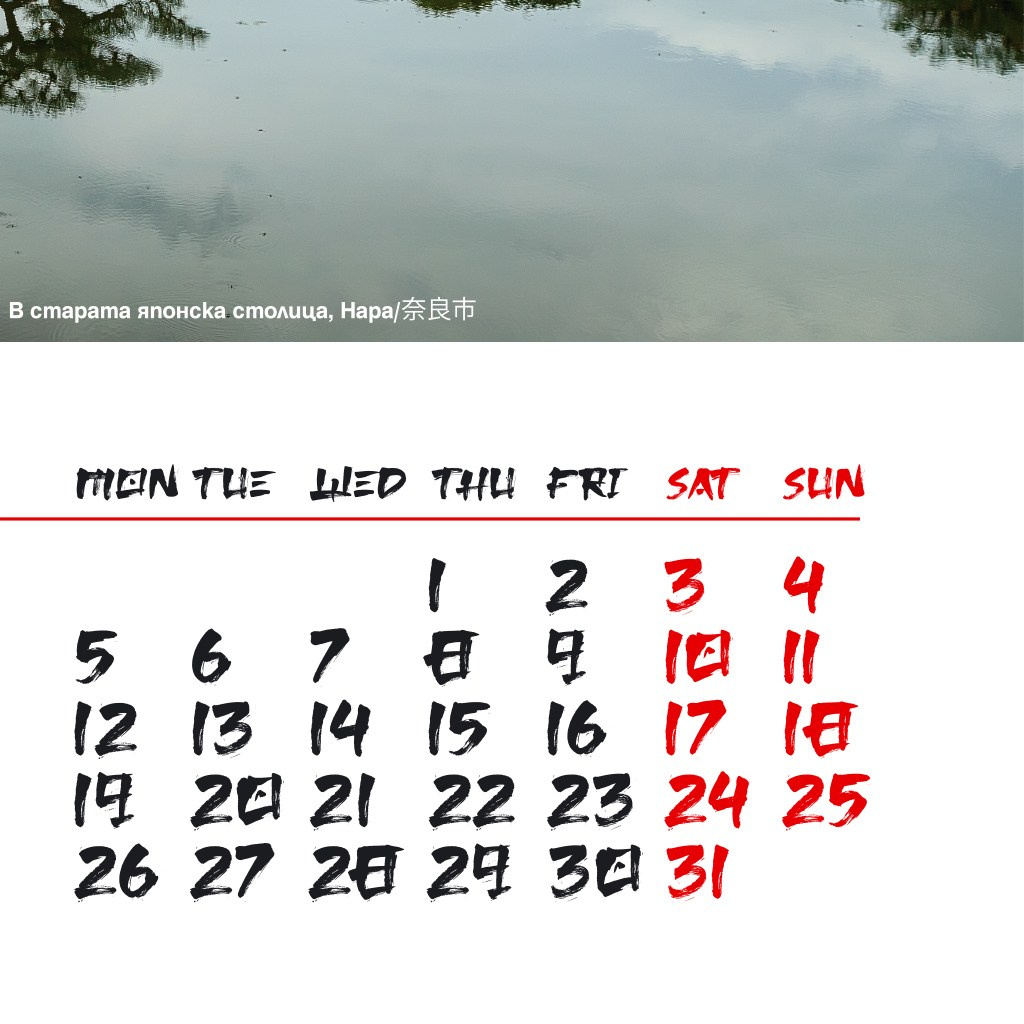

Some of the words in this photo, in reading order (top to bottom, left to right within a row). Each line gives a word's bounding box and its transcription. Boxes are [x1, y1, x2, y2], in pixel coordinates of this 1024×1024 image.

[77, 465, 178, 500] MON
[192, 467, 276, 499] TUE
[310, 466, 406, 502] WED
[432, 467, 514, 501] THU
[547, 467, 628, 500] FRI
[667, 467, 740, 500] SAT
[783, 464, 864, 500] SUN
[429, 558, 446, 612] 1
[546, 560, 588, 616] 2
[664, 558, 704, 612] 3
[784, 556, 824, 614] 4
[76, 630, 117, 684] 5
[192, 629, 231, 683] 6
[310, 628, 350, 683] 7
[423, 630, 479, 686] 8
[547, 629, 586, 685] 9
[666, 630, 733, 684] 10
[784, 630, 820, 684] 11
[74, 701, 137, 759] 12
[193, 701, 252, 755] 13
[311, 700, 371, 757] 14
[429, 701, 490, 756] 15
[547, 700, 606, 756] 16
[665, 700, 726, 756] 17
[785, 701, 858, 757] 18
[74, 772, 134, 828] 19
[190, 773, 284, 830] 20
[310, 773, 375, 831] 21
[429, 774, 515, 831] 22
[547, 773, 633, 831] 23
[664, 771, 749, 830] 24
[782, 773, 870, 830] 25
[74, 843, 158, 902] 26
[190, 843, 274, 902] 27
[309, 845, 404, 902] 28
[427, 844, 511, 902] 29
[549, 845, 643, 899] 30
[666, 845, 729, 899] 31
